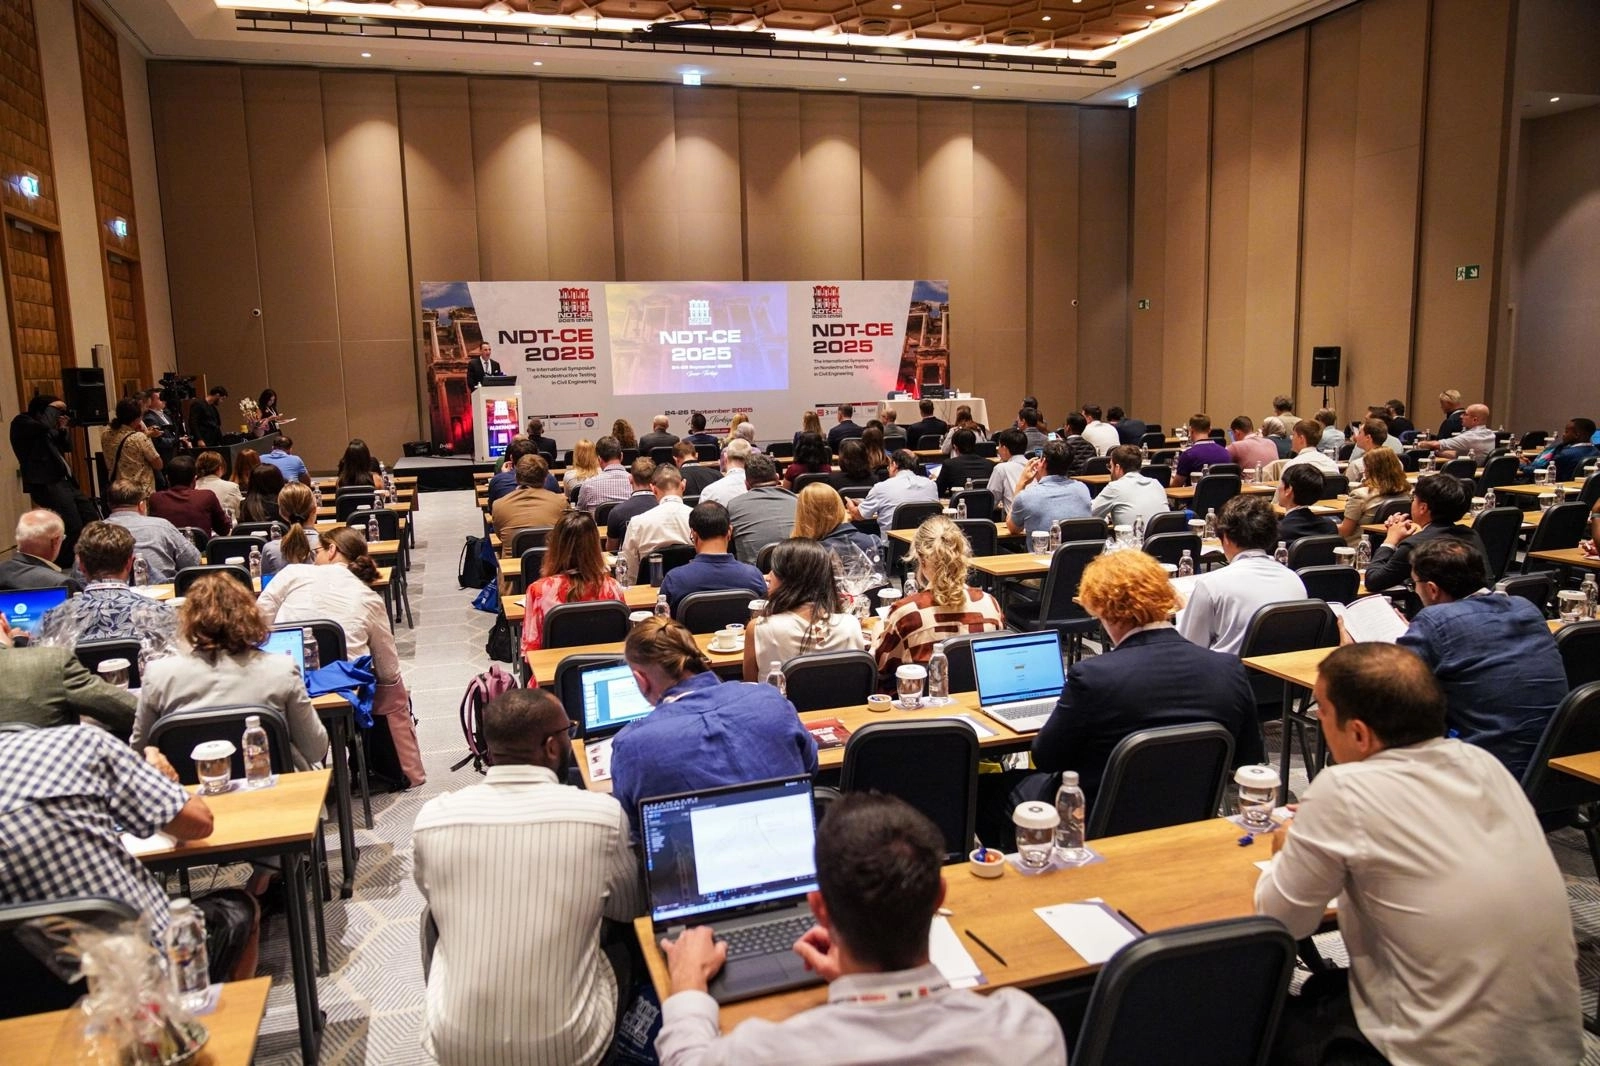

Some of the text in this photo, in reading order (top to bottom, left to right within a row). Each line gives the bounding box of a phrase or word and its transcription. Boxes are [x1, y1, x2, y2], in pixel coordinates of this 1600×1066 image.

[498, 329, 593, 344] NDT-CE
[659, 329, 741, 345] NDT-CE
[812, 323, 893, 337] NDT-CE
[525, 346, 594, 361] 2025
[813, 340, 873, 353] 2025
[671, 347, 732, 361] 2025
